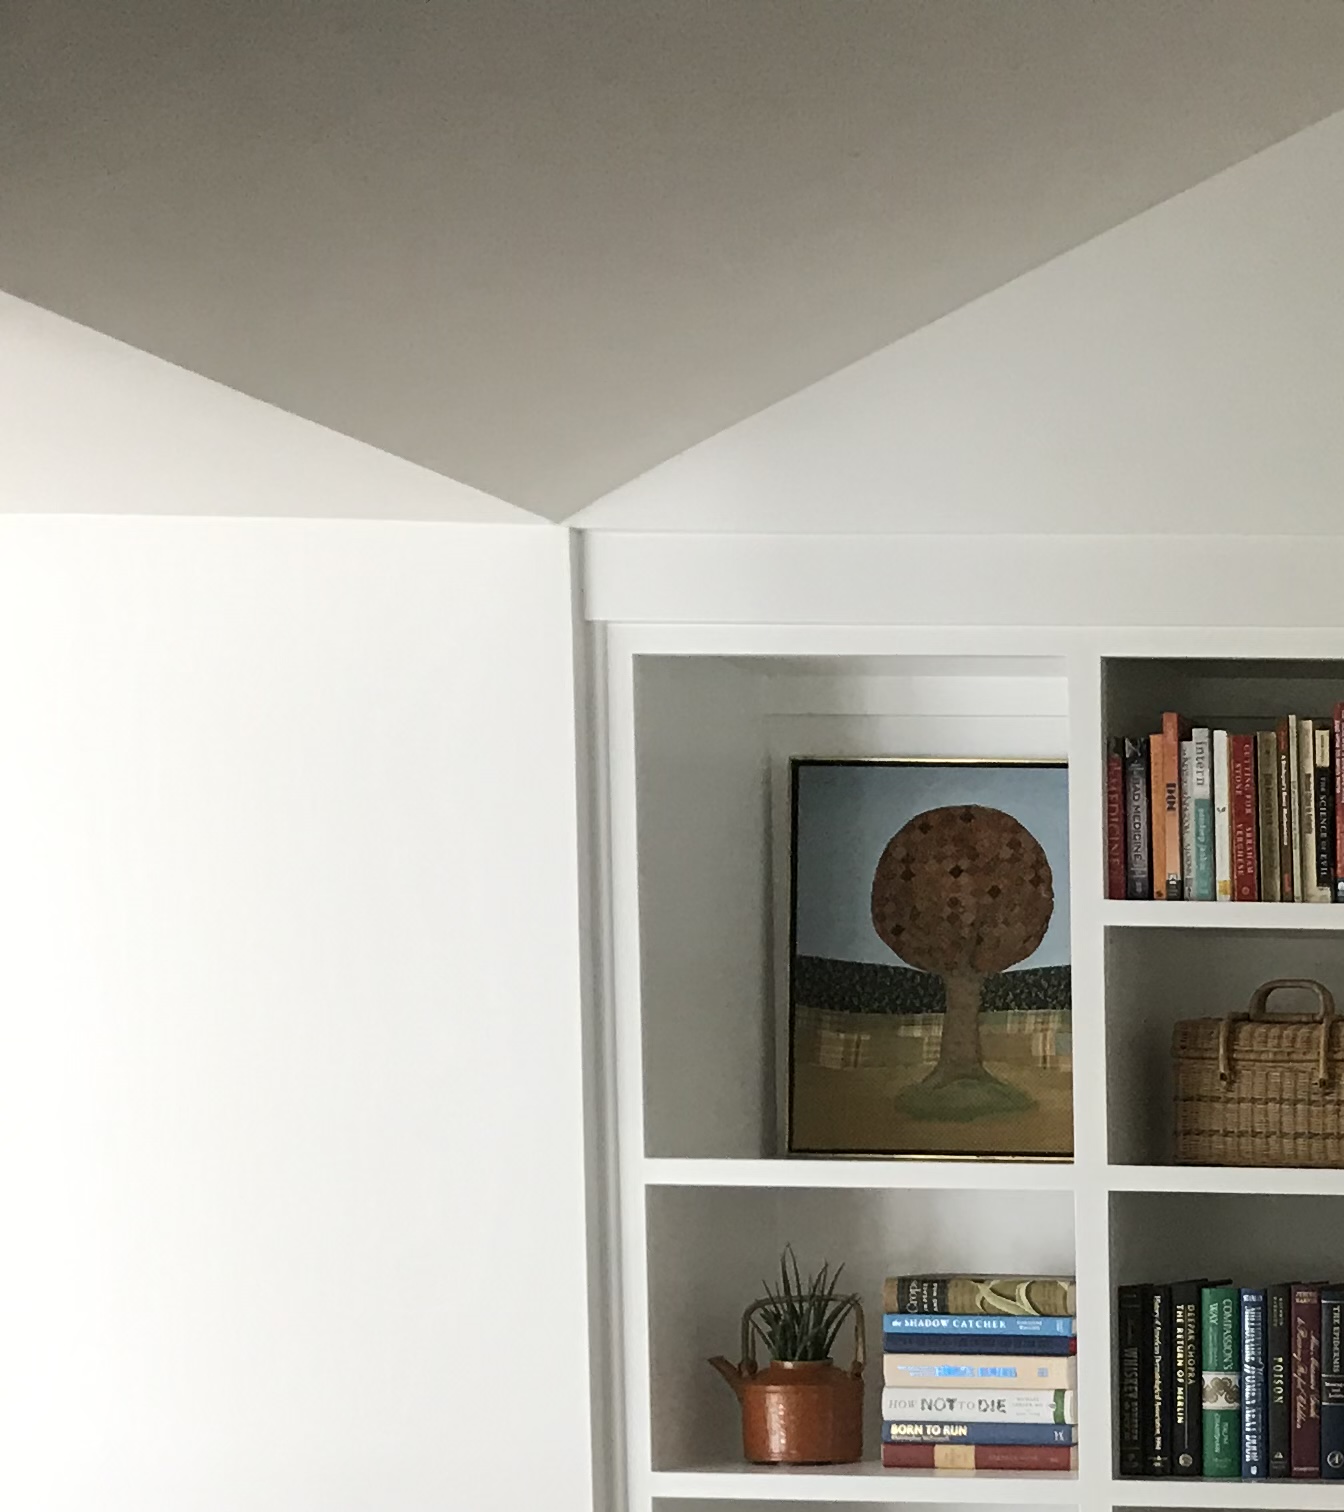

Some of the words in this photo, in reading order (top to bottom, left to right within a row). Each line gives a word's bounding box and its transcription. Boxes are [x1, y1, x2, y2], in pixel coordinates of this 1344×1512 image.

[1195, 741, 1206, 786] intern
[1234, 762, 1242, 796] STONE
[1244, 743, 1252, 791] CUTTING
[1132, 778, 1142, 801] BAD
[1131, 804, 1143, 861] MEDICINE
[1320, 794, 1328, 838] SCIENCE
[1236, 822, 1245, 876] VERGHESE
[1245, 826, 1254, 874] ABRAHAM
[1321, 853, 1329, 876] EVIL
[904, 1318, 950, 1328] SHADOW
[952, 1319, 1006, 1329] CATCHER
[1176, 1304, 1184, 1323] THE
[1187, 1304, 1196, 1341] DEEPAK
[1208, 1302, 1218, 1325] WAY
[1332, 1305, 1340, 1324] THE
[1176, 1327, 1184, 1367] RETURN
[1222, 1298, 1234, 1370] COMPASSION'S
[1332, 1326, 1341, 1372] EPIDERMIS
[1124, 1347, 1138, 1400] WHISKEY
[1176, 1369, 1184, 1383] OF
[1187, 1344, 1196, 1385] CHOPRA
[1272, 1356, 1284, 1404] POISON
[888, 1399, 916, 1409] HOW
[920, 1397, 958, 1412] NOT
[959, 1402, 976, 1410] TO
[978, 1398, 1006, 1414] DIE
[1176, 1386, 1184, 1424] MERLIN
[890, 1424, 923, 1436] BORN
[926, 1424, 941, 1436] TO
[942, 1424, 968, 1436] RUN
